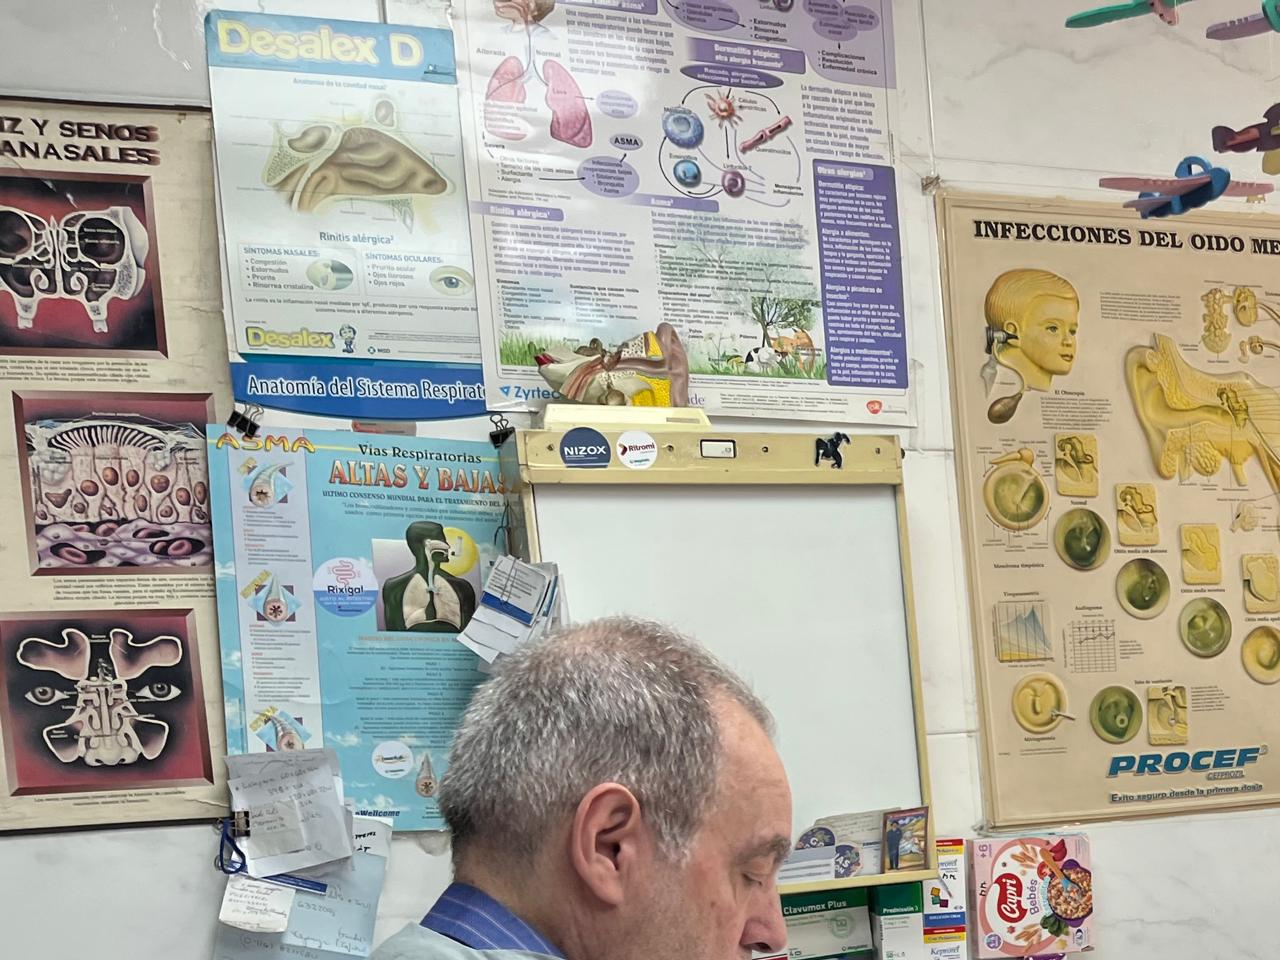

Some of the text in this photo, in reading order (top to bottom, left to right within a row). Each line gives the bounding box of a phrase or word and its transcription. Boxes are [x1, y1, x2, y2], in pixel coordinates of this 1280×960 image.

[217, 19, 424, 67] Desalex D
[31, 118, 49, 136] Y
[59, 120, 158, 142] SENOS
[614, 136, 640, 147] ASMA
[319, 231, 350, 242] Rinitis
[974, 220, 1131, 245] INFECCIONES
[1138, 230, 1183, 250] DEL
[1190, 234, 1245, 253] OIDO
[246, 326, 335, 349] Desalex
[249, 375, 325, 396] Anatomía
[329, 376, 353, 396] del
[357, 378, 417, 398] Sistema
[216, 432, 316, 454] ASMA
[392, 446, 482, 463] Respiratorias
[564, 446, 606, 455] NIZOX
[329, 459, 507, 495] ALTAS Y BAJAS
[327, 584, 364, 597] Rixigal
[1107, 747, 1261, 777] PROCEF
[1137, 791, 1166, 802] seguro
[1170, 788, 1195, 798] desde
[827, 900, 847, 910] Plus
[1001, 878, 1020, 919] Capri
[1027, 879, 1040, 915] Bebés
